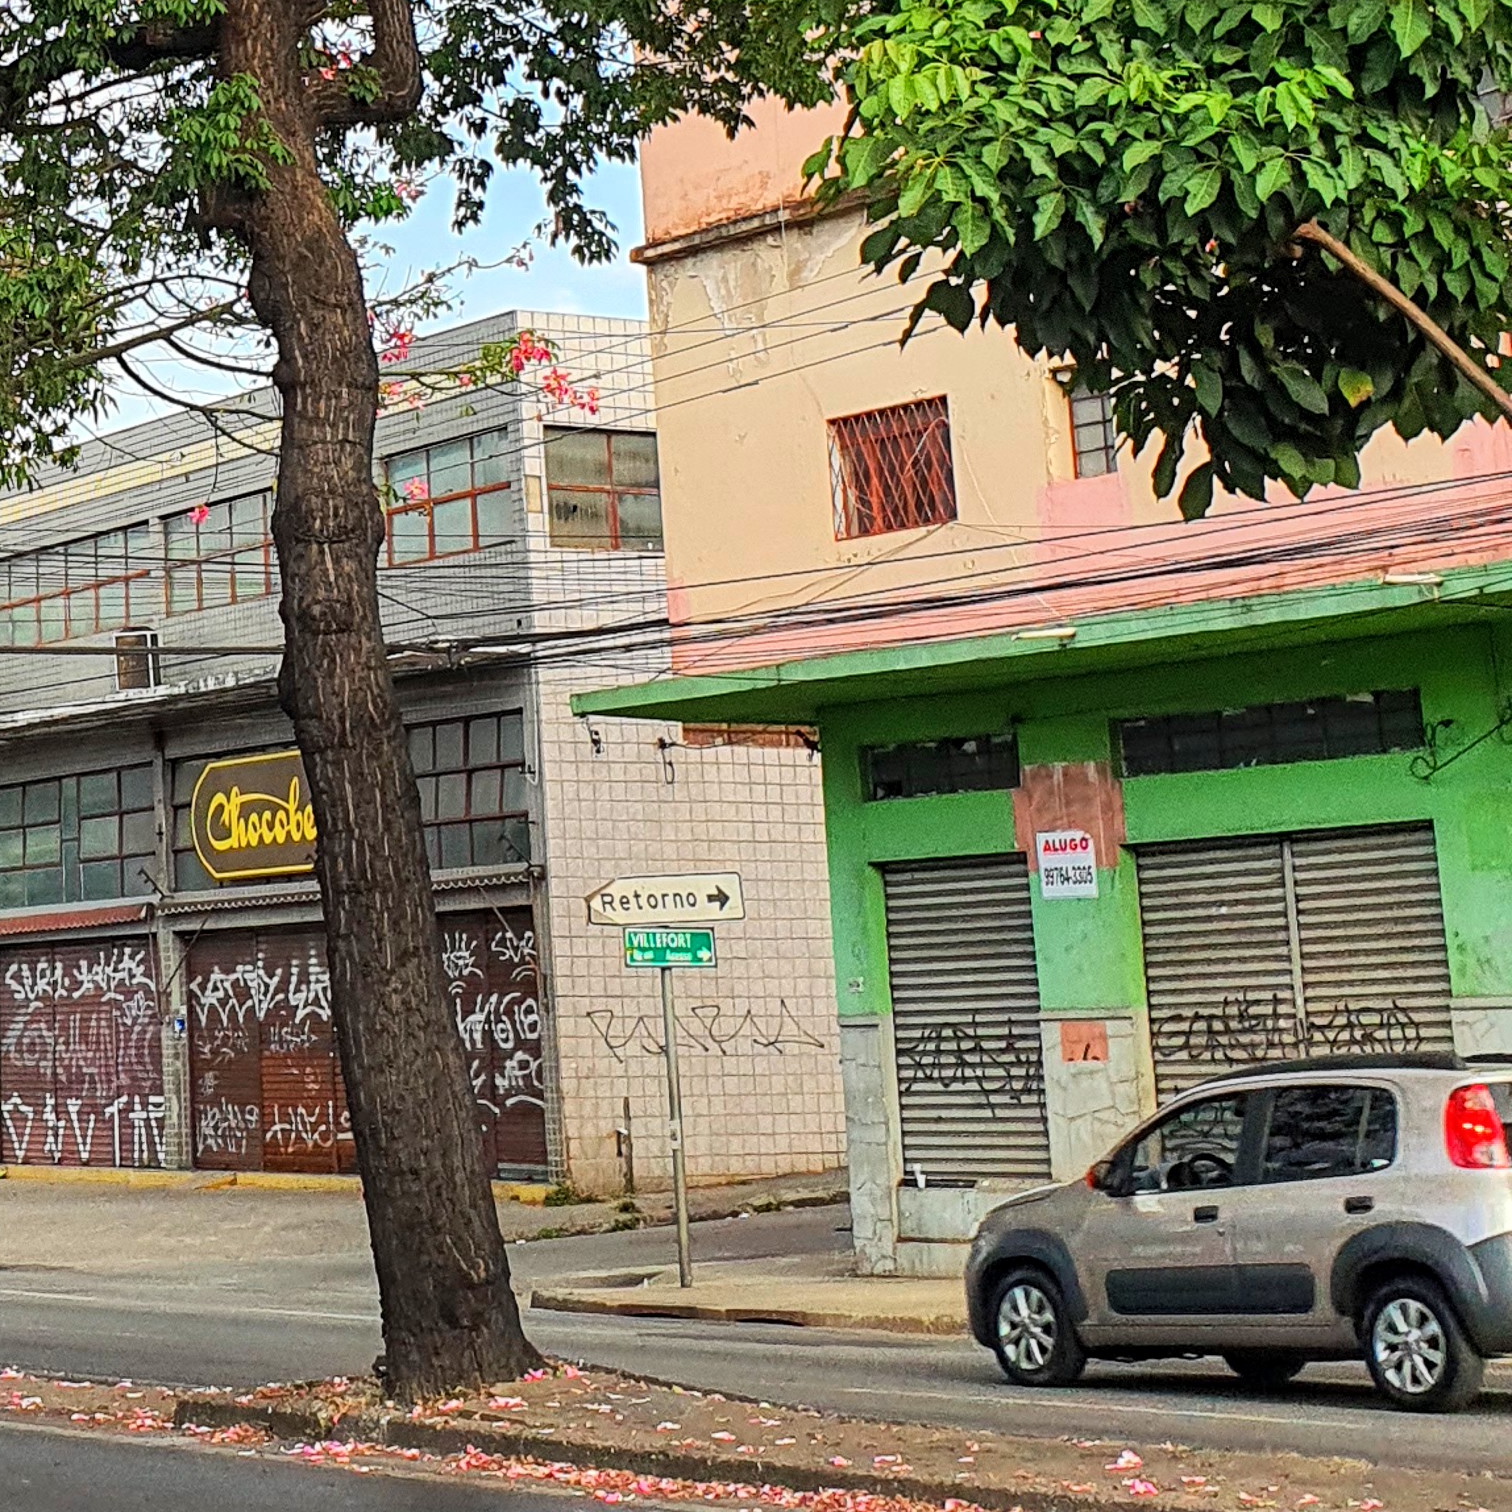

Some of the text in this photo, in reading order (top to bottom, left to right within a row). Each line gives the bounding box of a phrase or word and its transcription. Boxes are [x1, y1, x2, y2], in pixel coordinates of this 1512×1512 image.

[1043, 836, 1089, 853] ALUGO
[600, 889, 697, 913] Retorno
[630, 933, 692, 949] VILLEFORT
